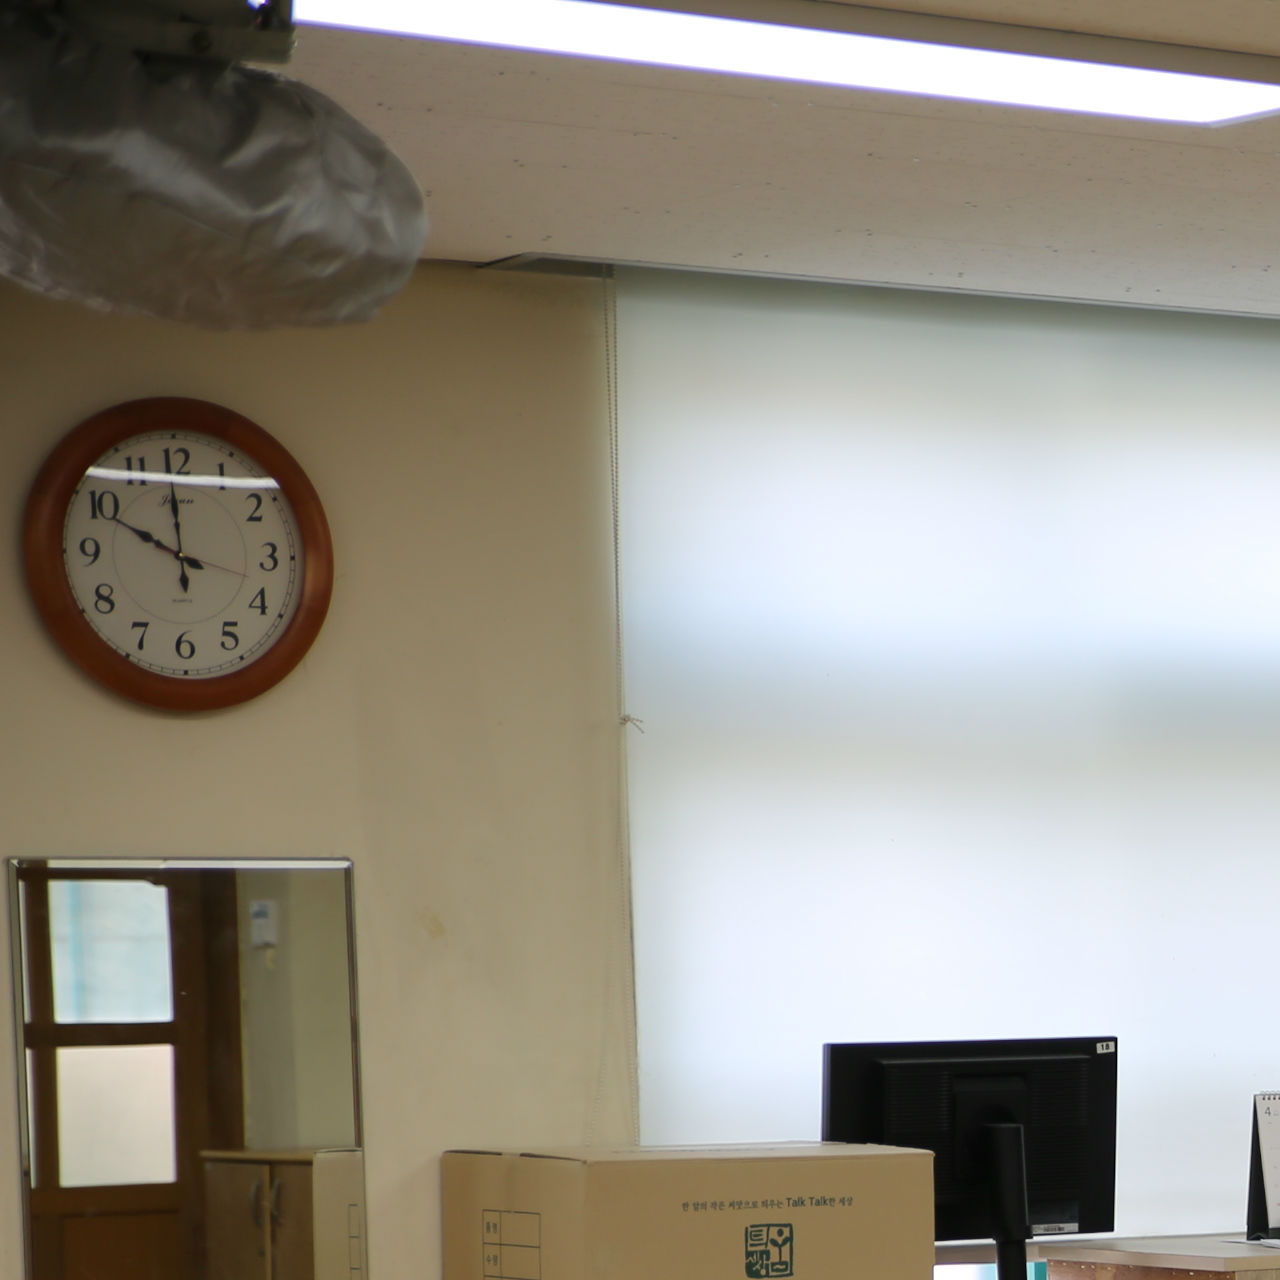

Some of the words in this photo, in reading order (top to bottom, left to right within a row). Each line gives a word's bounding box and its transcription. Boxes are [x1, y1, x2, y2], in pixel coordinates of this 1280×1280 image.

[125, 456, 147, 486] 11
[163, 447, 190, 476] 12
[218, 462, 227, 490] 1
[89, 490, 120, 520] 10
[246, 494, 263, 521] 2
[79, 537, 100, 567] 9
[259, 542, 279, 571] 3
[94, 584, 115, 614] 8
[249, 587, 268, 616] 4
[131, 622, 149, 650] 7
[175, 630, 196, 659] 6
[220, 621, 239, 650] 5
[1264, 1106, 1272, 1117] 4
[786, 1196, 806, 1209] Talk
